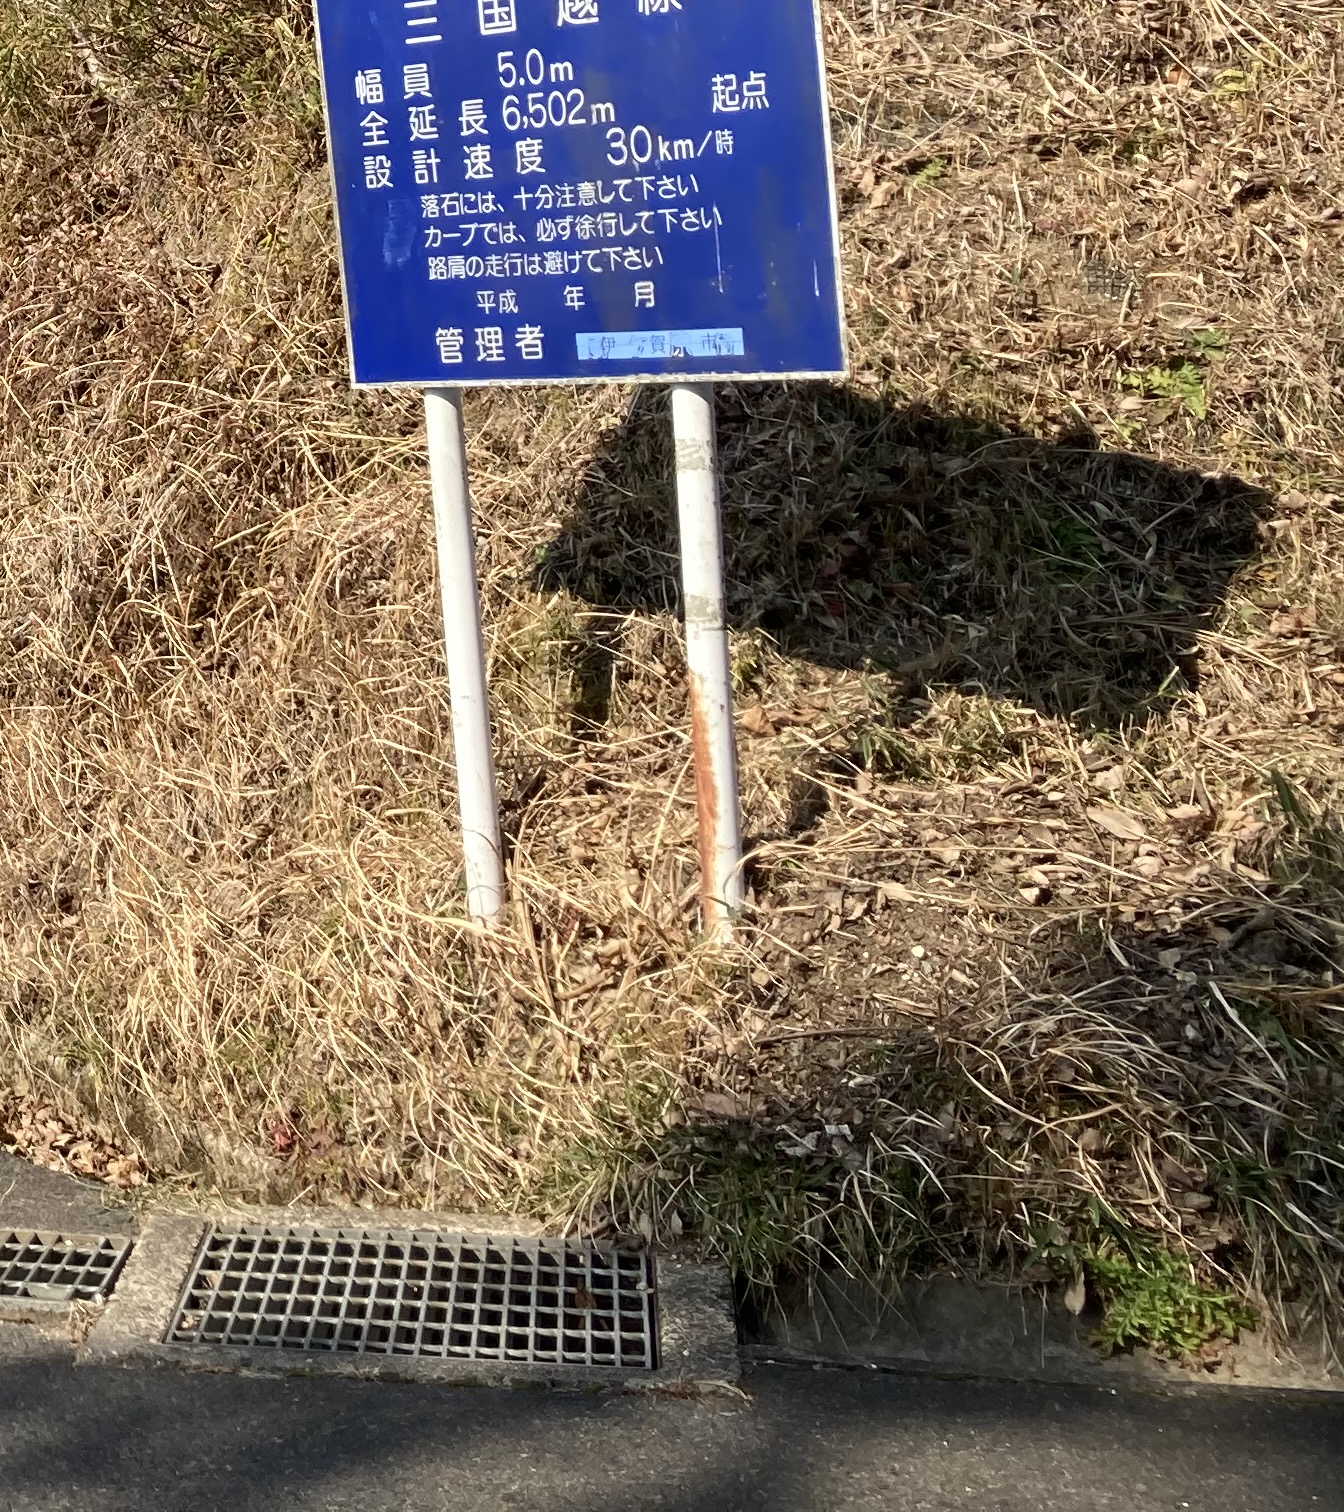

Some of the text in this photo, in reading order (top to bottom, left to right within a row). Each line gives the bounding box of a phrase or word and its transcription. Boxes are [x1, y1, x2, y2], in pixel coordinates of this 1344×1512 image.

[355, 63, 434, 105] 幅員
[712, 71, 770, 113] 起点
[360, 99, 489, 146] 全延長
[364, 137, 547, 189] 設計速度
[421, 174, 699, 219] 落石には、十分注意して下さい
[424, 204, 723, 248] カーブでは、必ず徐行して下さい
[428, 246, 664, 281] 路肩の走行は避けて下さい
[476, 281, 656, 315] 平成 年 月
[435, 324, 545, 364] 管理者
